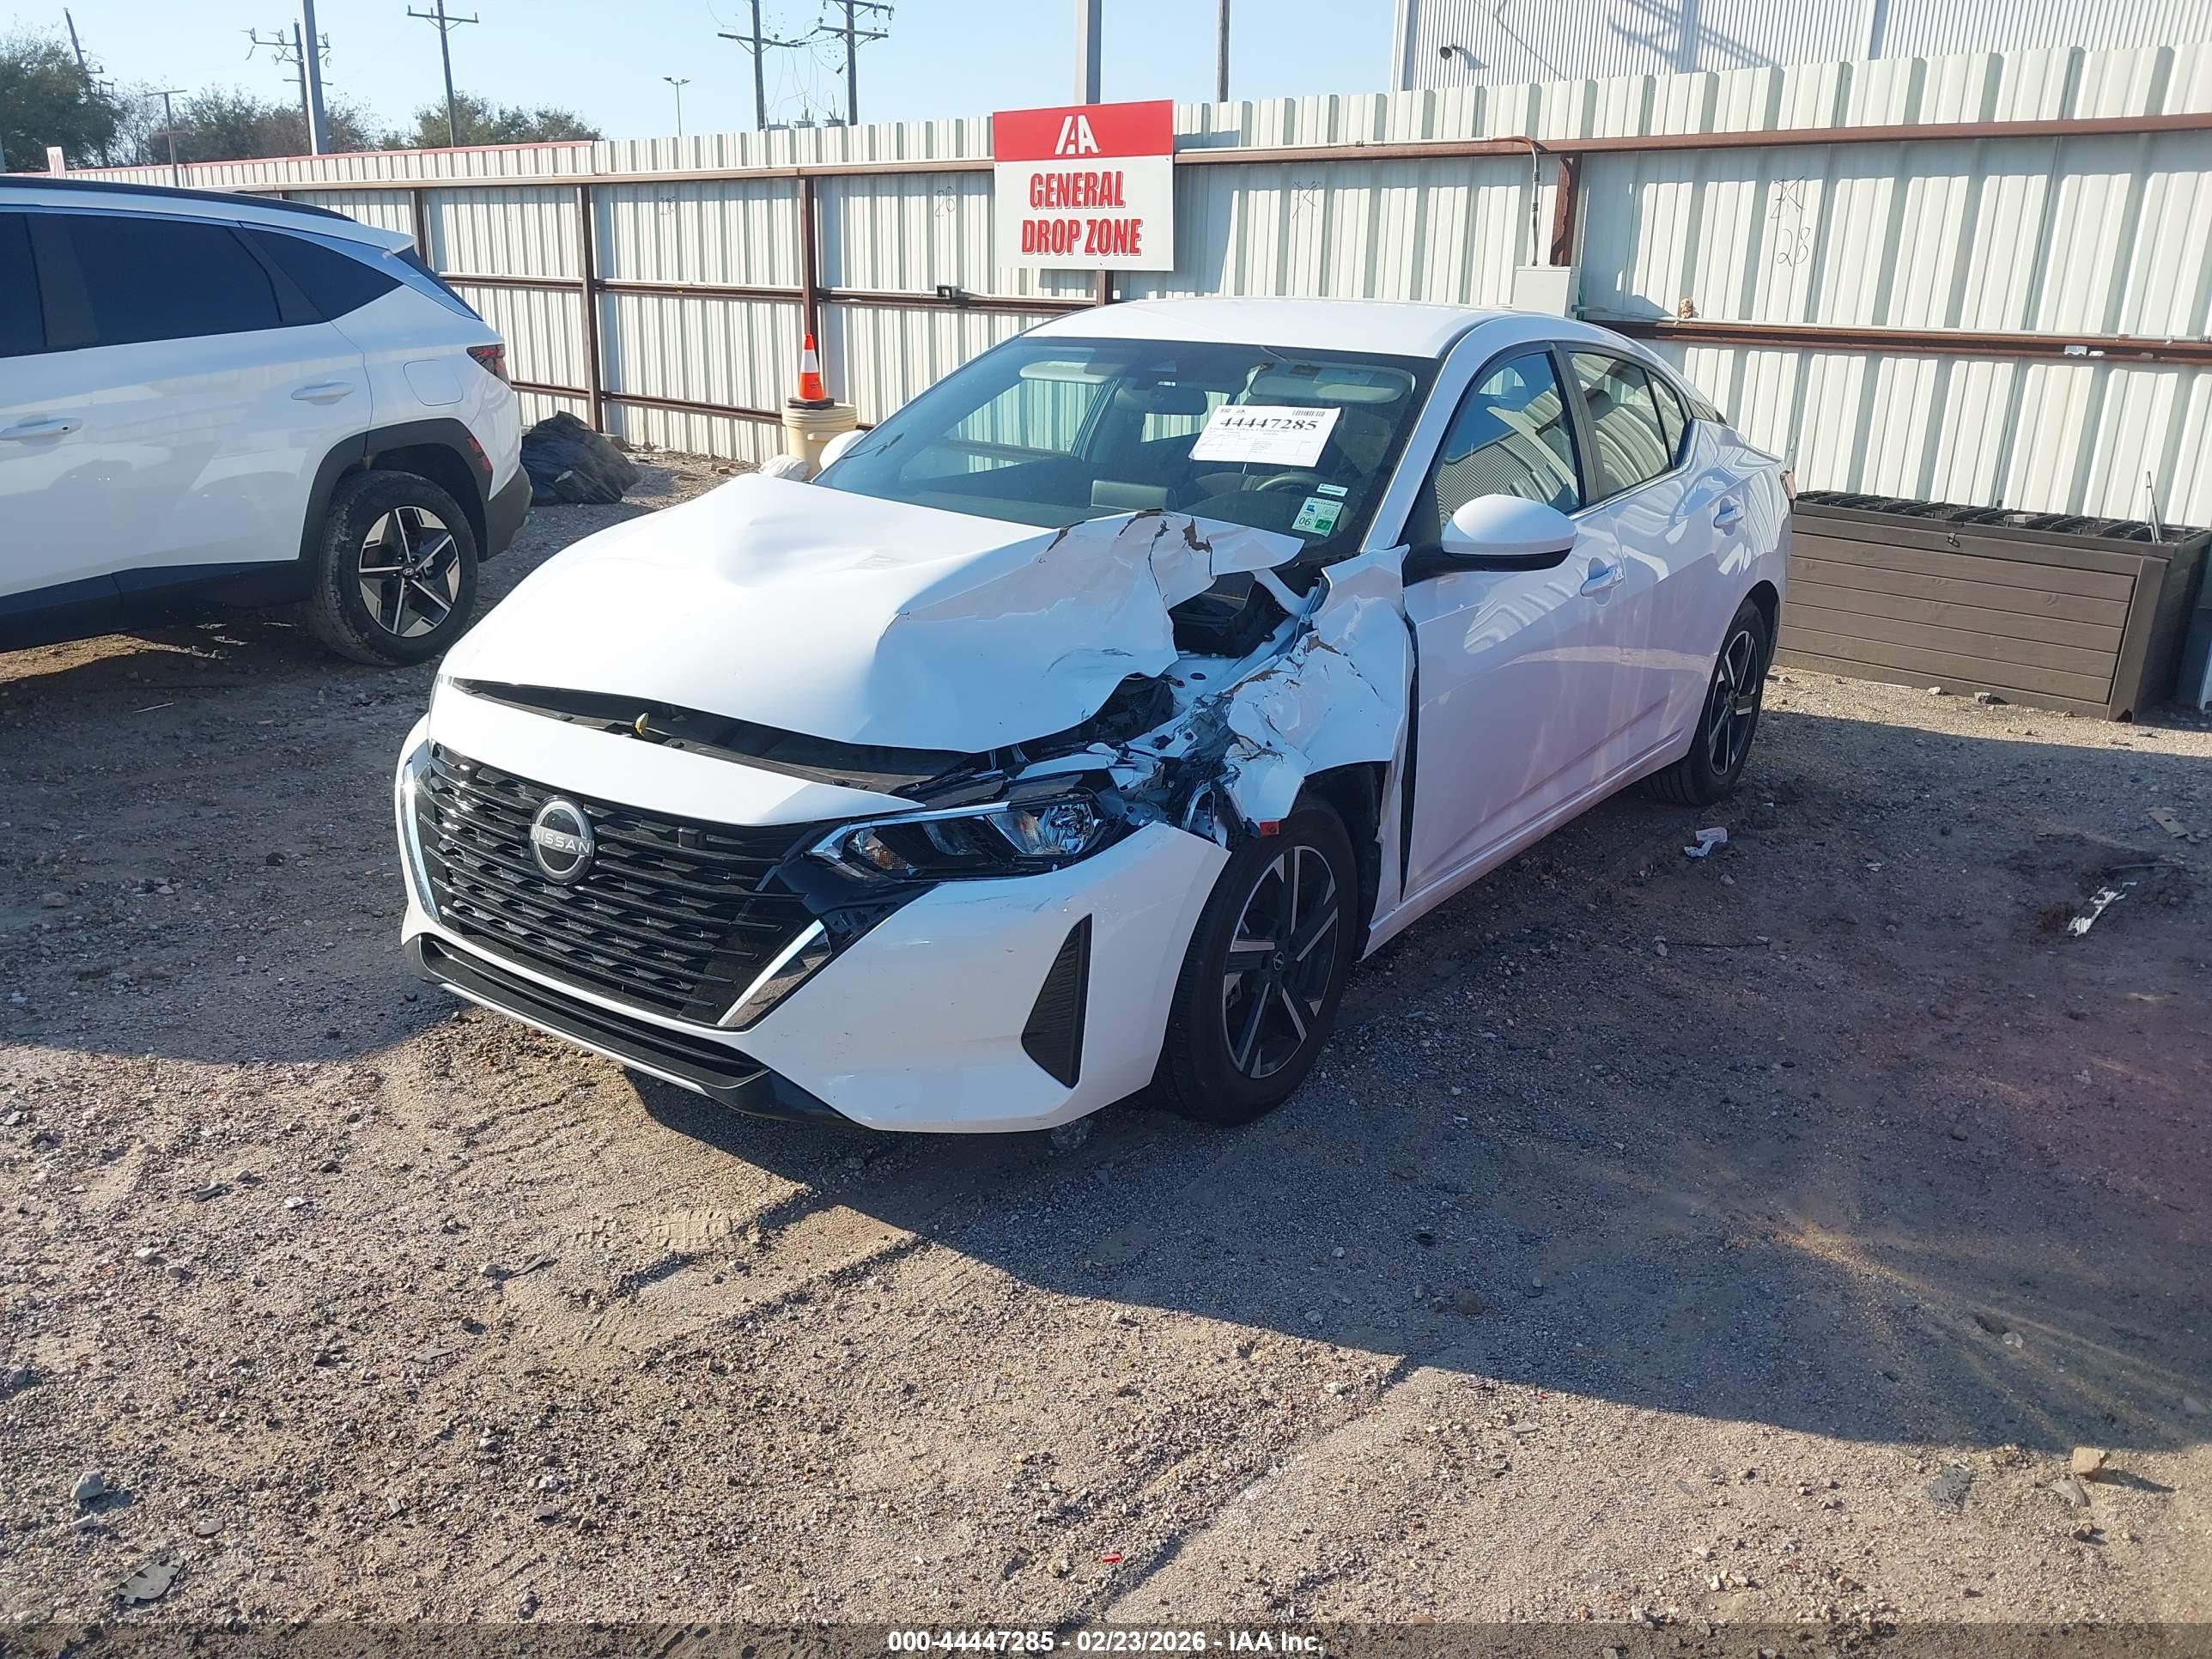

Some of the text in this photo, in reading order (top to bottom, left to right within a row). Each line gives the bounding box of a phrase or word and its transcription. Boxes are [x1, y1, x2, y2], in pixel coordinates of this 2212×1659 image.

[1030, 171, 1126, 210] GENERAL
[1021, 218, 1143, 256] DROP ZONE
[1219, 416, 1319, 431] 44447285
[1298, 517, 1312, 526] 06
[532, 828, 591, 854] NISSAN
